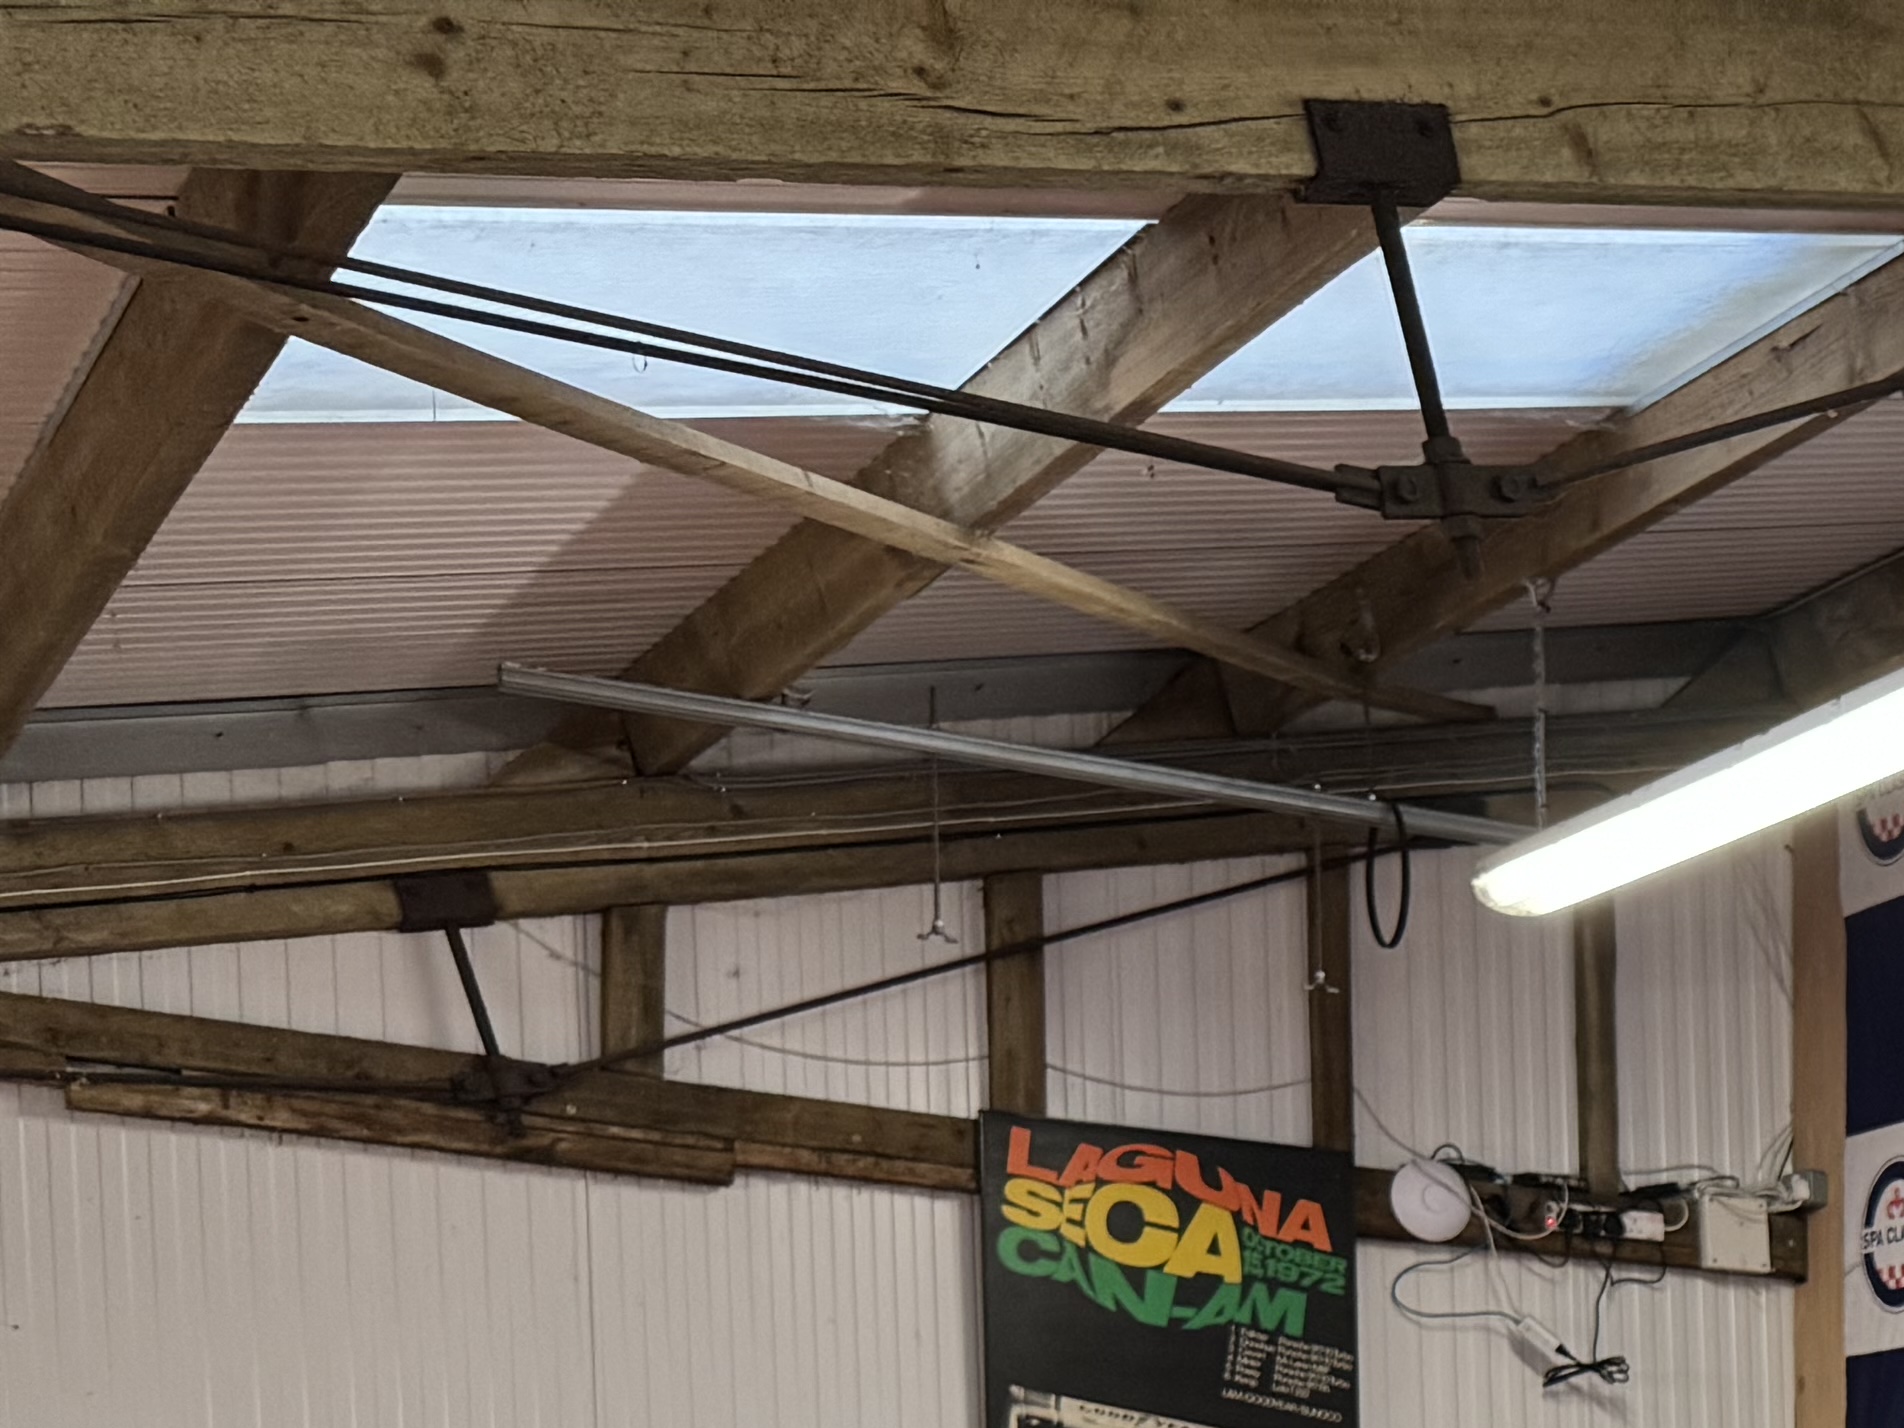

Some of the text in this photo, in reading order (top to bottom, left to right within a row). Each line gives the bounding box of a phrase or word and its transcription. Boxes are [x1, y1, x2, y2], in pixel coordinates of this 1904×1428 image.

[1002, 1178, 1242, 1284] SECA
[1007, 1126, 1332, 1251] LAGUNA
[1863, 1230, 1884, 1249] SPA
[997, 1226, 1307, 1336] CAN-AM
